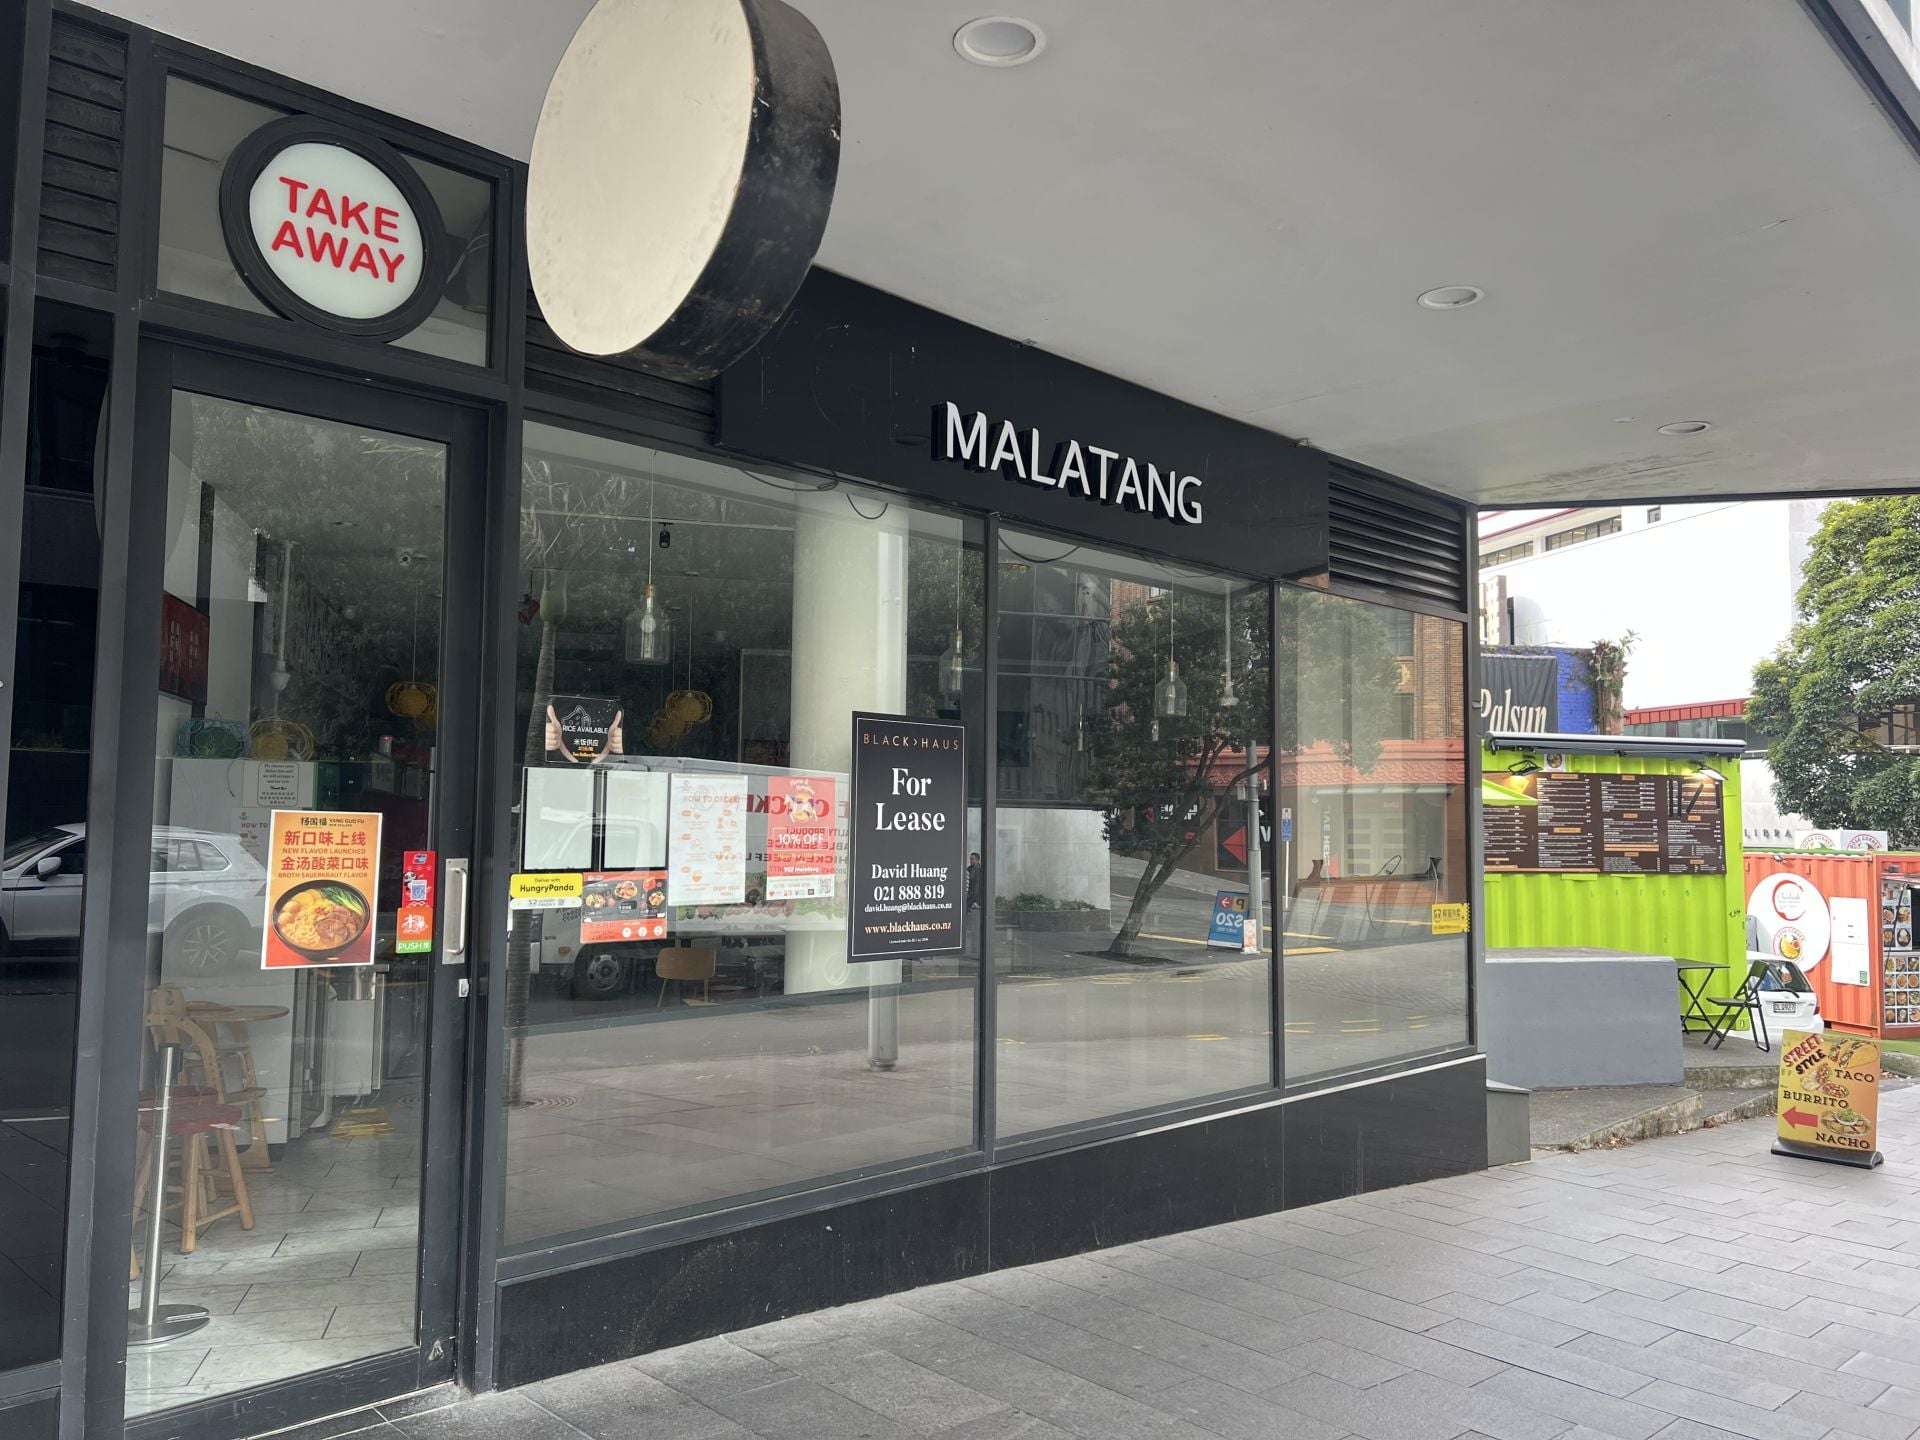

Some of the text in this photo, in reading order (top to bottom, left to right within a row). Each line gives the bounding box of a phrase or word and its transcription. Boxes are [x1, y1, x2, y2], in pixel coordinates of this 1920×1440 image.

[279, 176, 400, 243] TAKE
[272, 220, 405, 283] AWAY
[946, 400, 1203, 524] MALATANG
[577, 726, 609, 734] AVAILABLE
[892, 767, 932, 796] For
[876, 802, 946, 831] Lease
[284, 830, 367, 846] 新口味上线
[281, 856, 369, 871] 金汤酸菜口味
[871, 863, 949, 882] David Huang
[520, 883, 574, 893] HungryPanda
[873, 884, 945, 901] 021 888 819
[864, 902, 952, 913] david.huang@blackhaus.co.nz
[864, 921, 952, 934] www.blackhaus.co.nz
[1783, 1033, 1824, 1067] STREET
[1795, 1048, 1827, 1075] STYLE
[1834, 1069, 1875, 1083] TACO
[1783, 1090, 1849, 1109] BURRITO
[1815, 1132, 1871, 1149] NACHO
